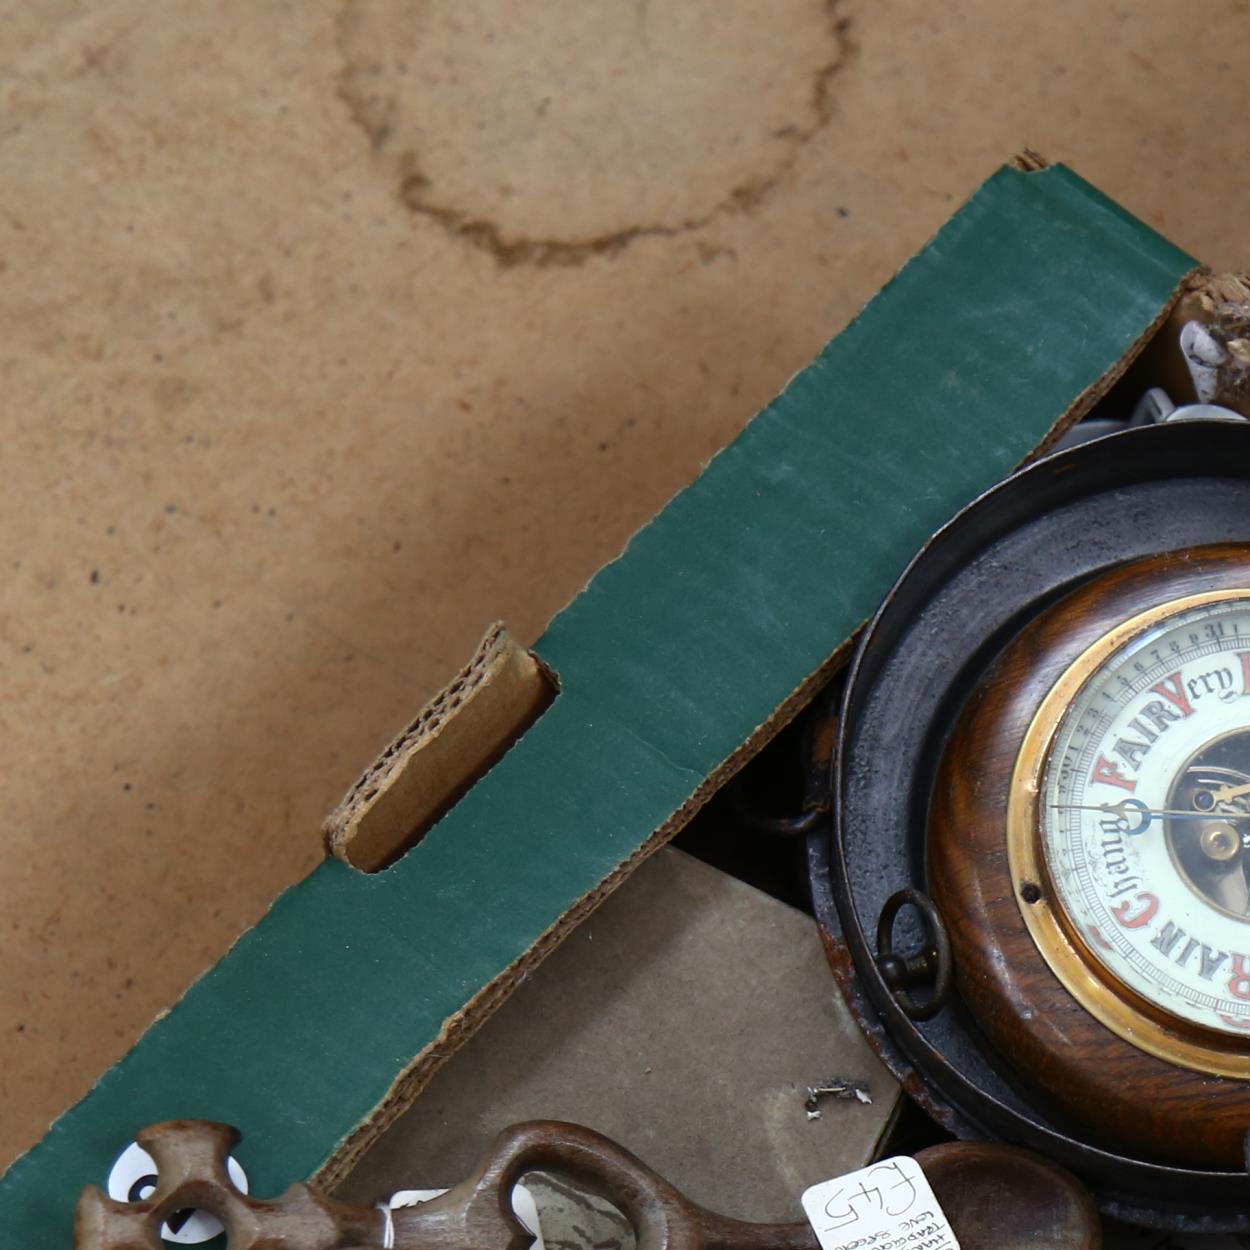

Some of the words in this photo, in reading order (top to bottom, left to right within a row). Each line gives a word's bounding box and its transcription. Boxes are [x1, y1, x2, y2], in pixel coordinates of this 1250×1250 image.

[1204, 622, 1224, 639] 31
[1146, 667, 1239, 720] Very
[1089, 700, 1182, 793] FAIR
[1100, 804, 1159, 929] Chang
[824, 1161, 917, 1233] £45
